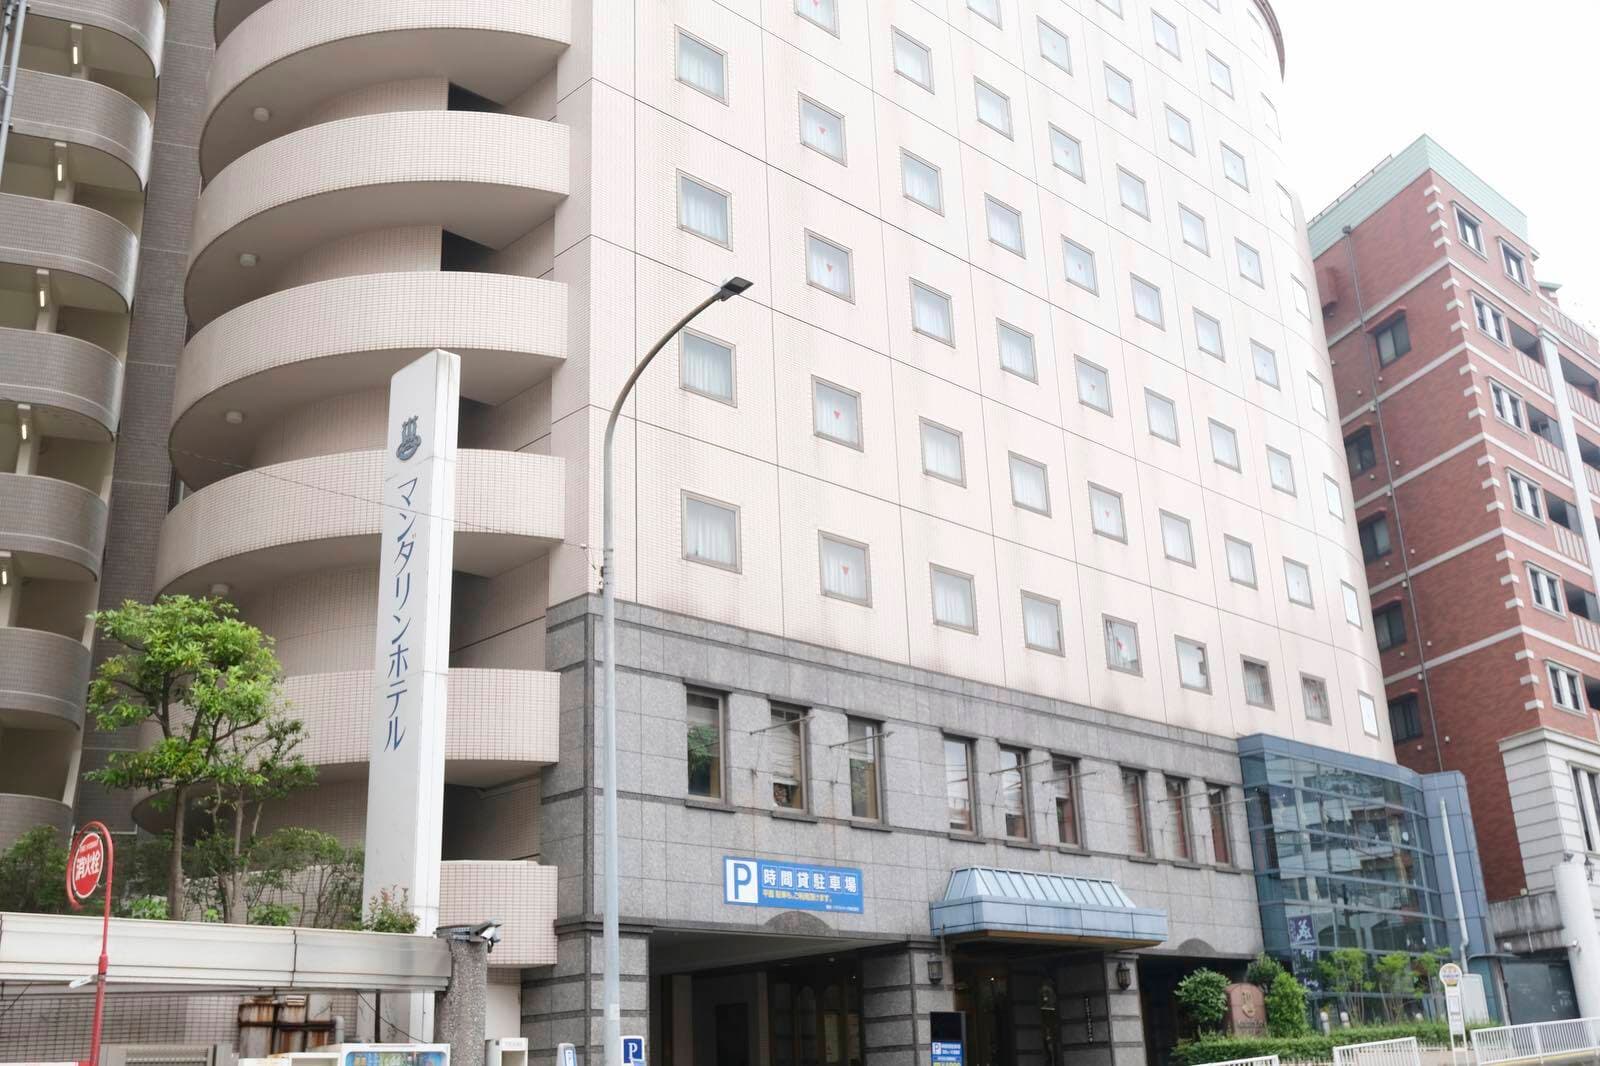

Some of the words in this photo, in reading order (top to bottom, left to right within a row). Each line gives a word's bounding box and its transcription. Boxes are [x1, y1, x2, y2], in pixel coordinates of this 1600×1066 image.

[383, 477, 418, 753] マンダリンホテル
[75, 850, 101, 880] 消火栓
[733, 863, 752, 899] P
[763, 868, 857, 893] 時間貸駐車場
[628, 1043, 638, 1060] P
